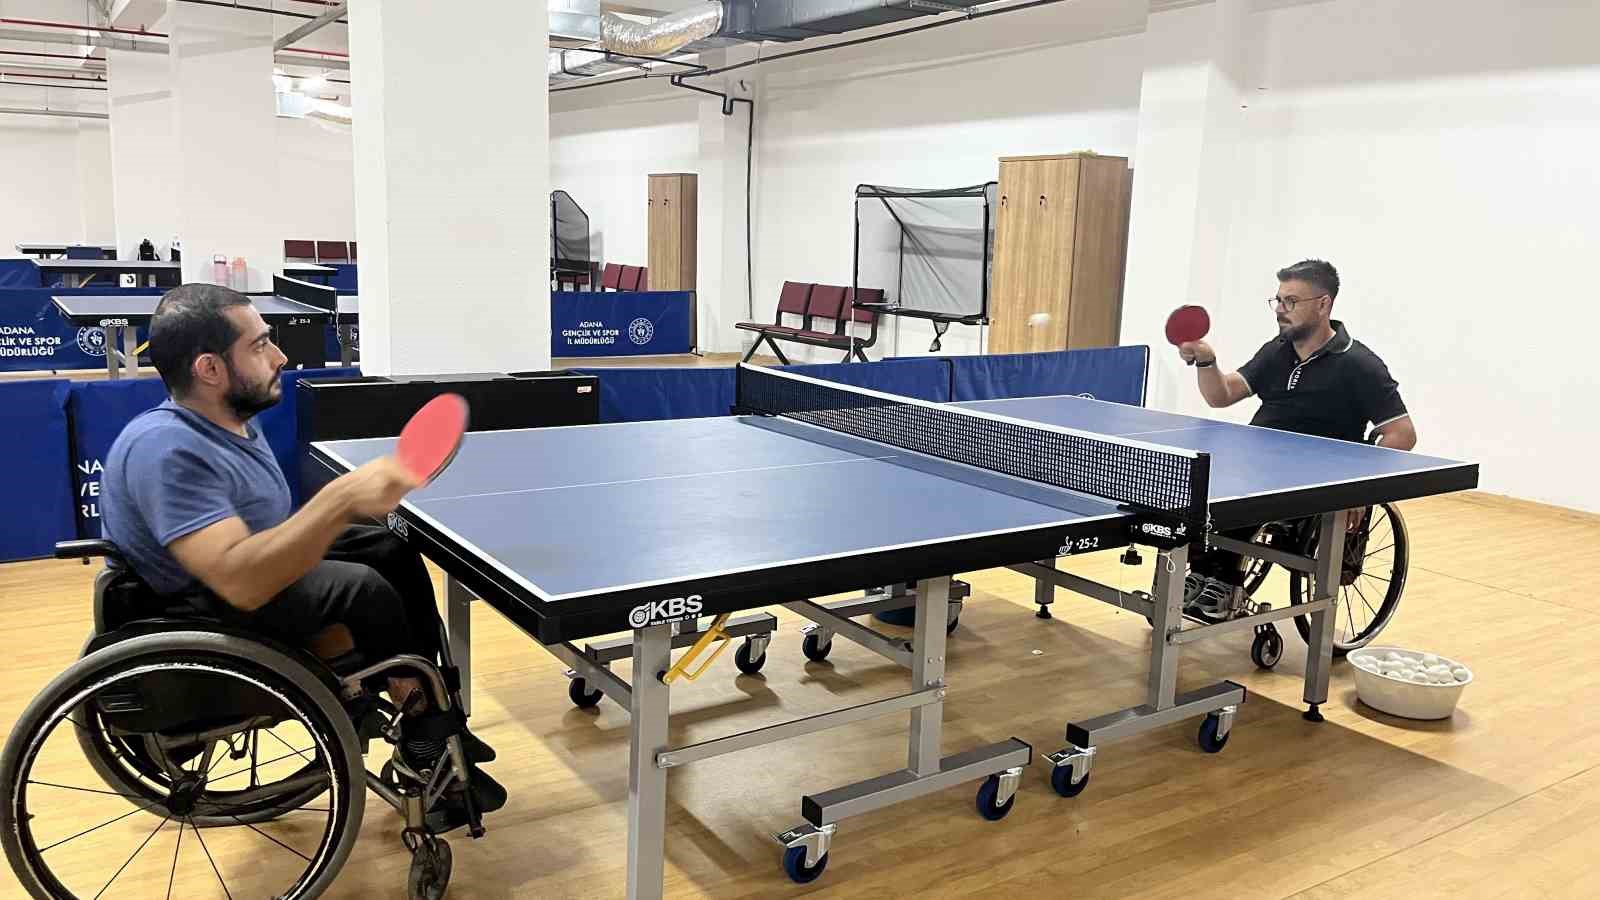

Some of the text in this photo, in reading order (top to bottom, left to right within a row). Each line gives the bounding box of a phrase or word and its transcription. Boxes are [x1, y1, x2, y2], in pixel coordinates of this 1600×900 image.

[0, 336, 61, 346] LİK VE SPOR
[1149, 523, 1172, 536] KBS
[650, 594, 703, 620] KBS
